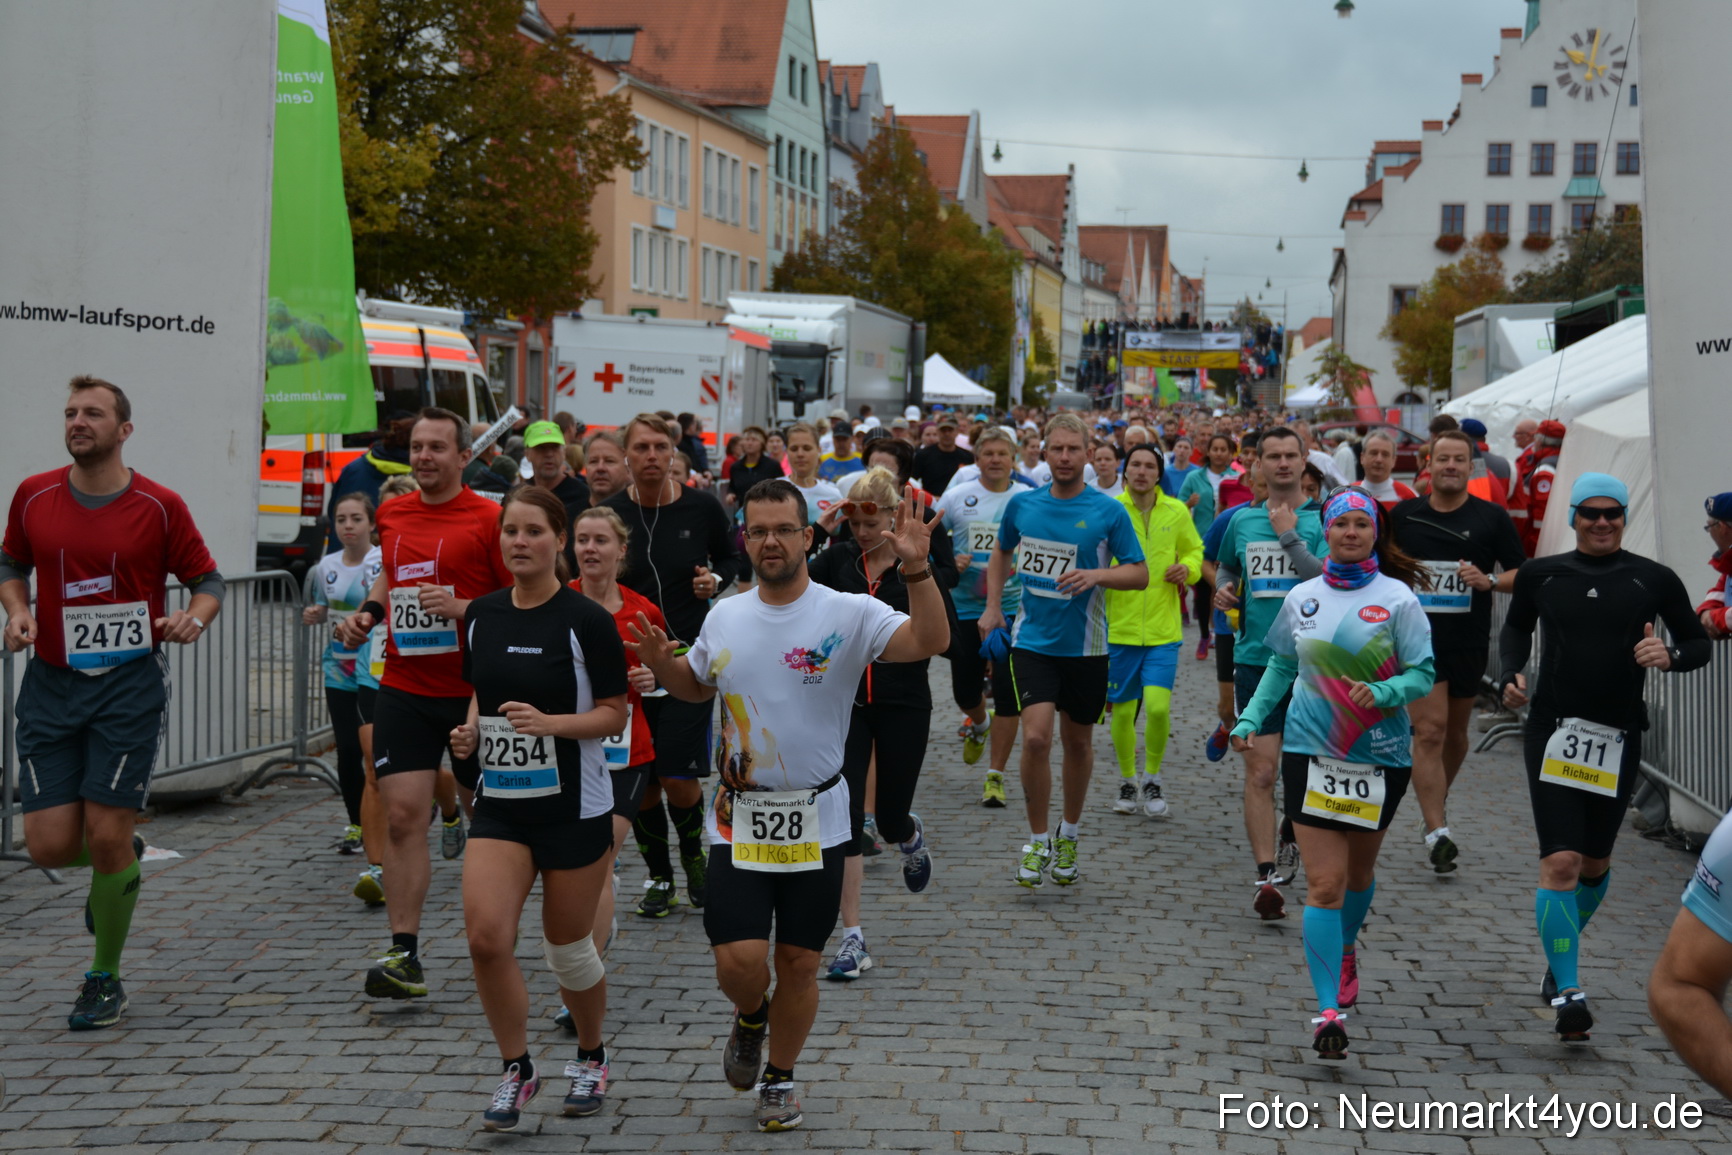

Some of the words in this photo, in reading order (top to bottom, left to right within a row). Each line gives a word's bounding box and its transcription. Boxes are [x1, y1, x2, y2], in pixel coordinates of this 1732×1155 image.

[0, 300, 215, 335] w.bmw-laufsport.de
[1160, 355, 1200, 365] START
[628, 364, 685, 375] Bayerisches
[628, 375, 655, 385] Rotes
[627, 387, 655, 396] Kreuz
[1038, 544, 1067, 555] Neumarkt
[1022, 551, 1071, 577] 2577
[1251, 555, 1299, 576] 2414
[78, 583, 99, 592] DEHN
[1024, 576, 1058, 590] Sebastia
[1266, 580, 1280, 589] Kai
[65, 613, 94, 621] PARTL
[95, 611, 134, 619] Neumarkt
[74, 620, 144, 650] 2473
[401, 636, 439, 646] Andreas
[99, 654, 120, 666] Tim
[802, 675, 823, 685] 2012
[1369, 728, 1387, 741] 16.
[1579, 726, 1614, 741] Neumarkt
[484, 736, 548, 767] 2254
[1562, 734, 1607, 767] 311
[1313, 761, 1335, 773] ARTL
[1336, 766, 1371, 777] Neumarkt
[1562, 765, 1600, 784] Richard
[497, 775, 532, 787] Carina
[1323, 774, 1370, 799] 310
[736, 798, 763, 808] PARTL
[763, 798, 806, 808] Neumarkt
[1325, 798, 1361, 815] Claudia
[751, 811, 803, 841] 528
